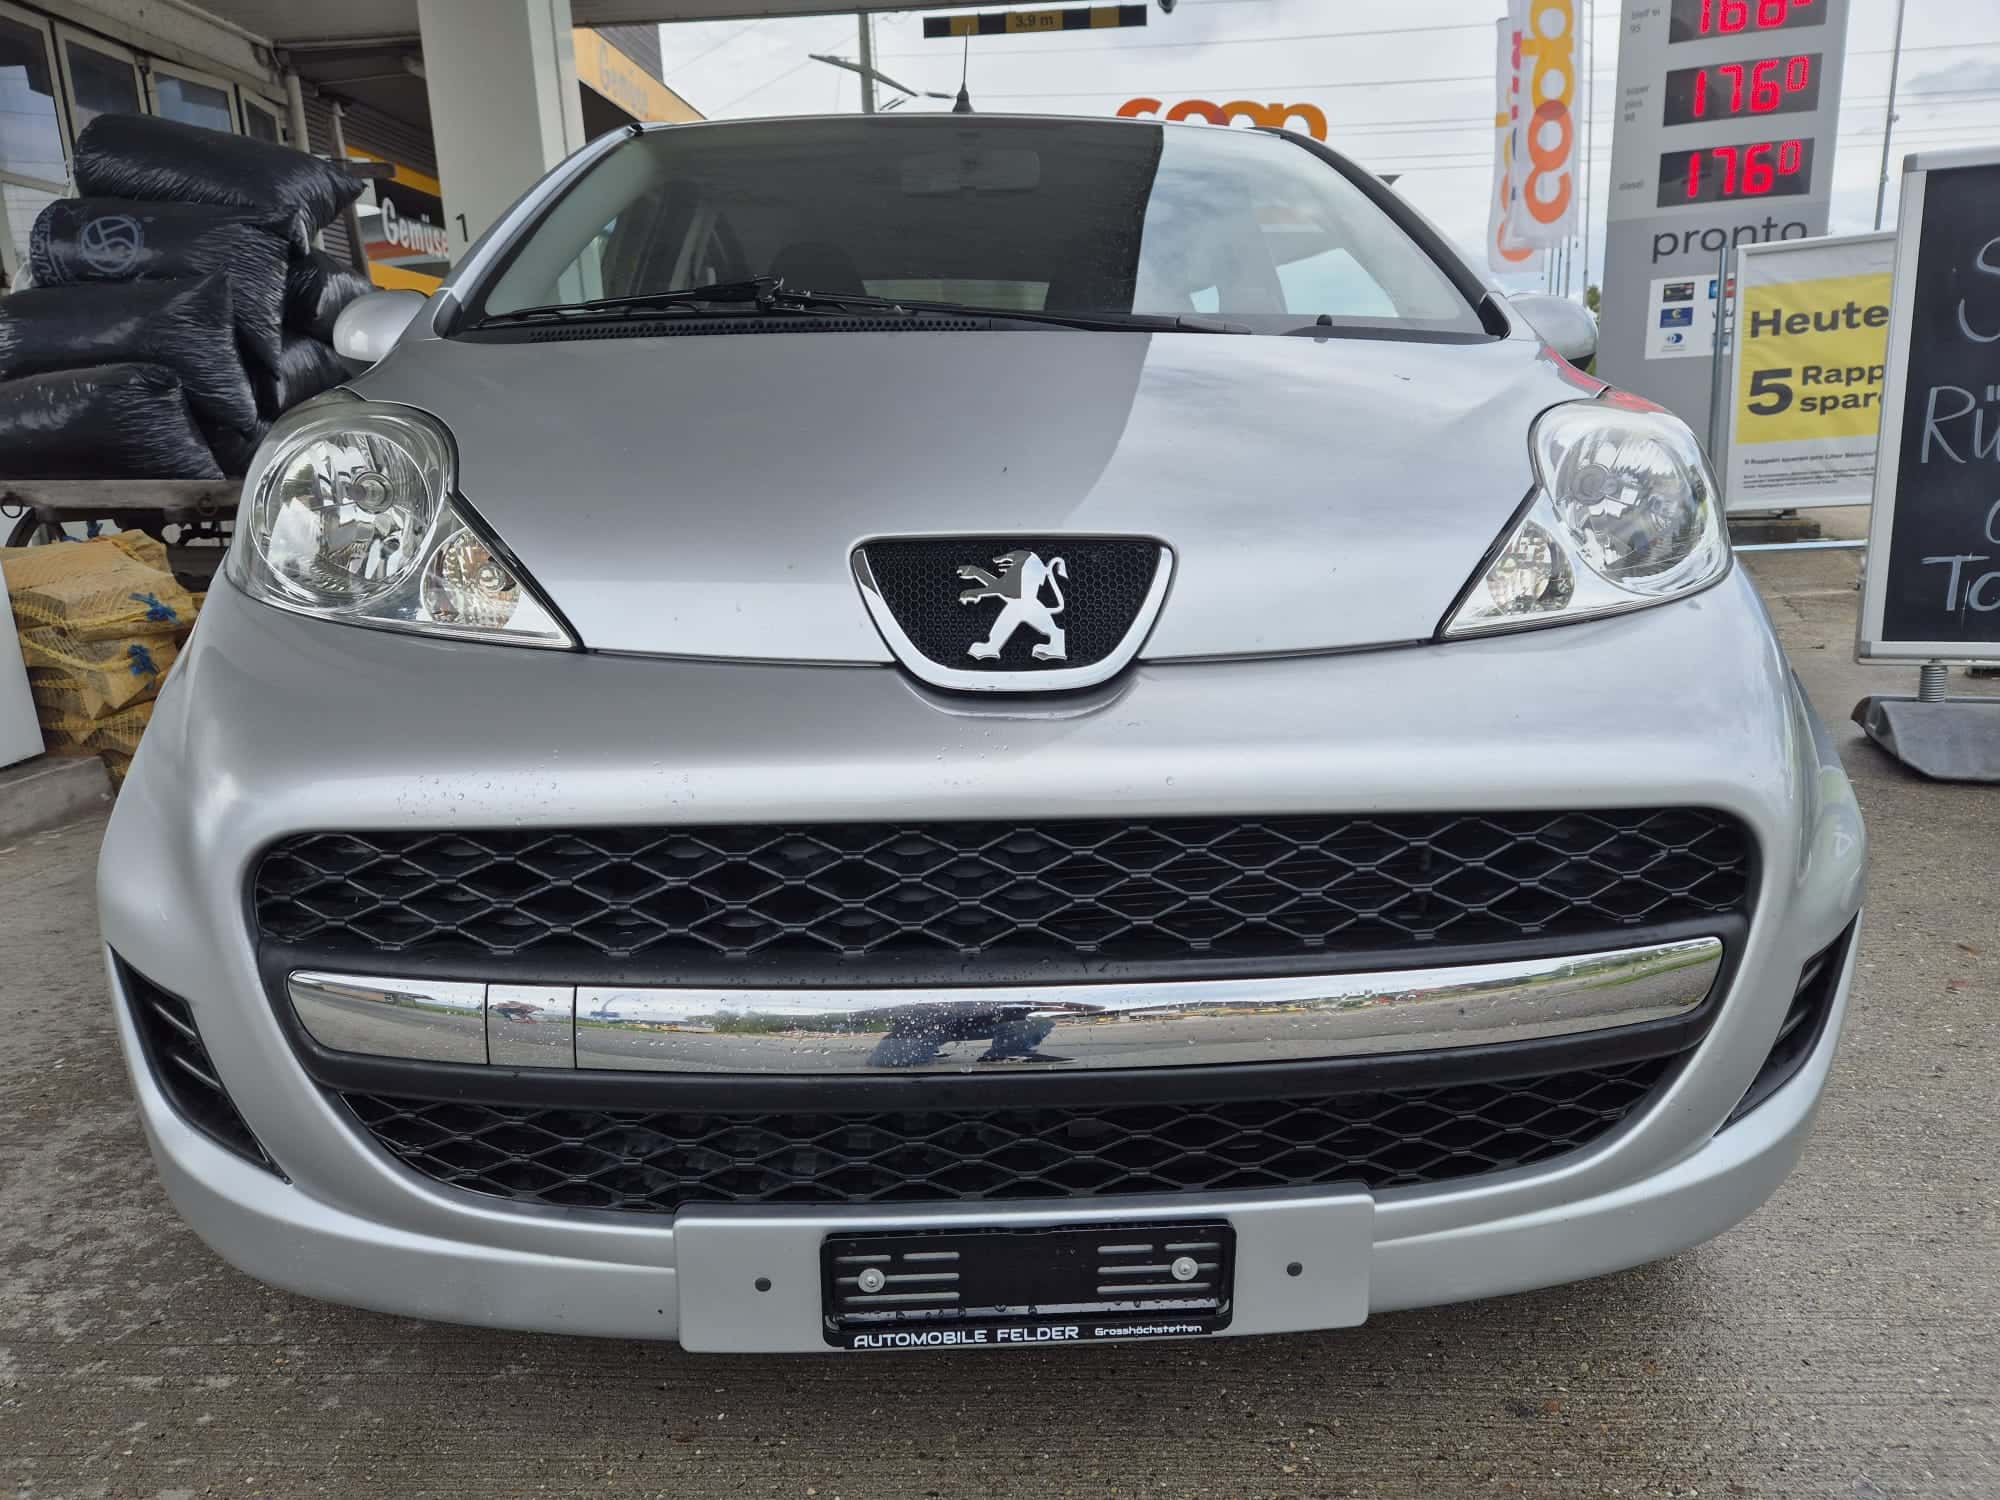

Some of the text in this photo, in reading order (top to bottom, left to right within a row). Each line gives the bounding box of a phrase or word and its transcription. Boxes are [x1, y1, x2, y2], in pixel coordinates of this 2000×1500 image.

[1040, 14, 1055, 26] m
[456, 213, 468, 242] 1
[1652, 216, 1808, 264] pronto
[1751, 302, 1889, 338] Heute
[1747, 368, 1793, 416] 5
[1799, 391, 1882, 416] spar
[854, 1324, 1202, 1348] AUTOMOBILE FELDER Grosshöchstetten
